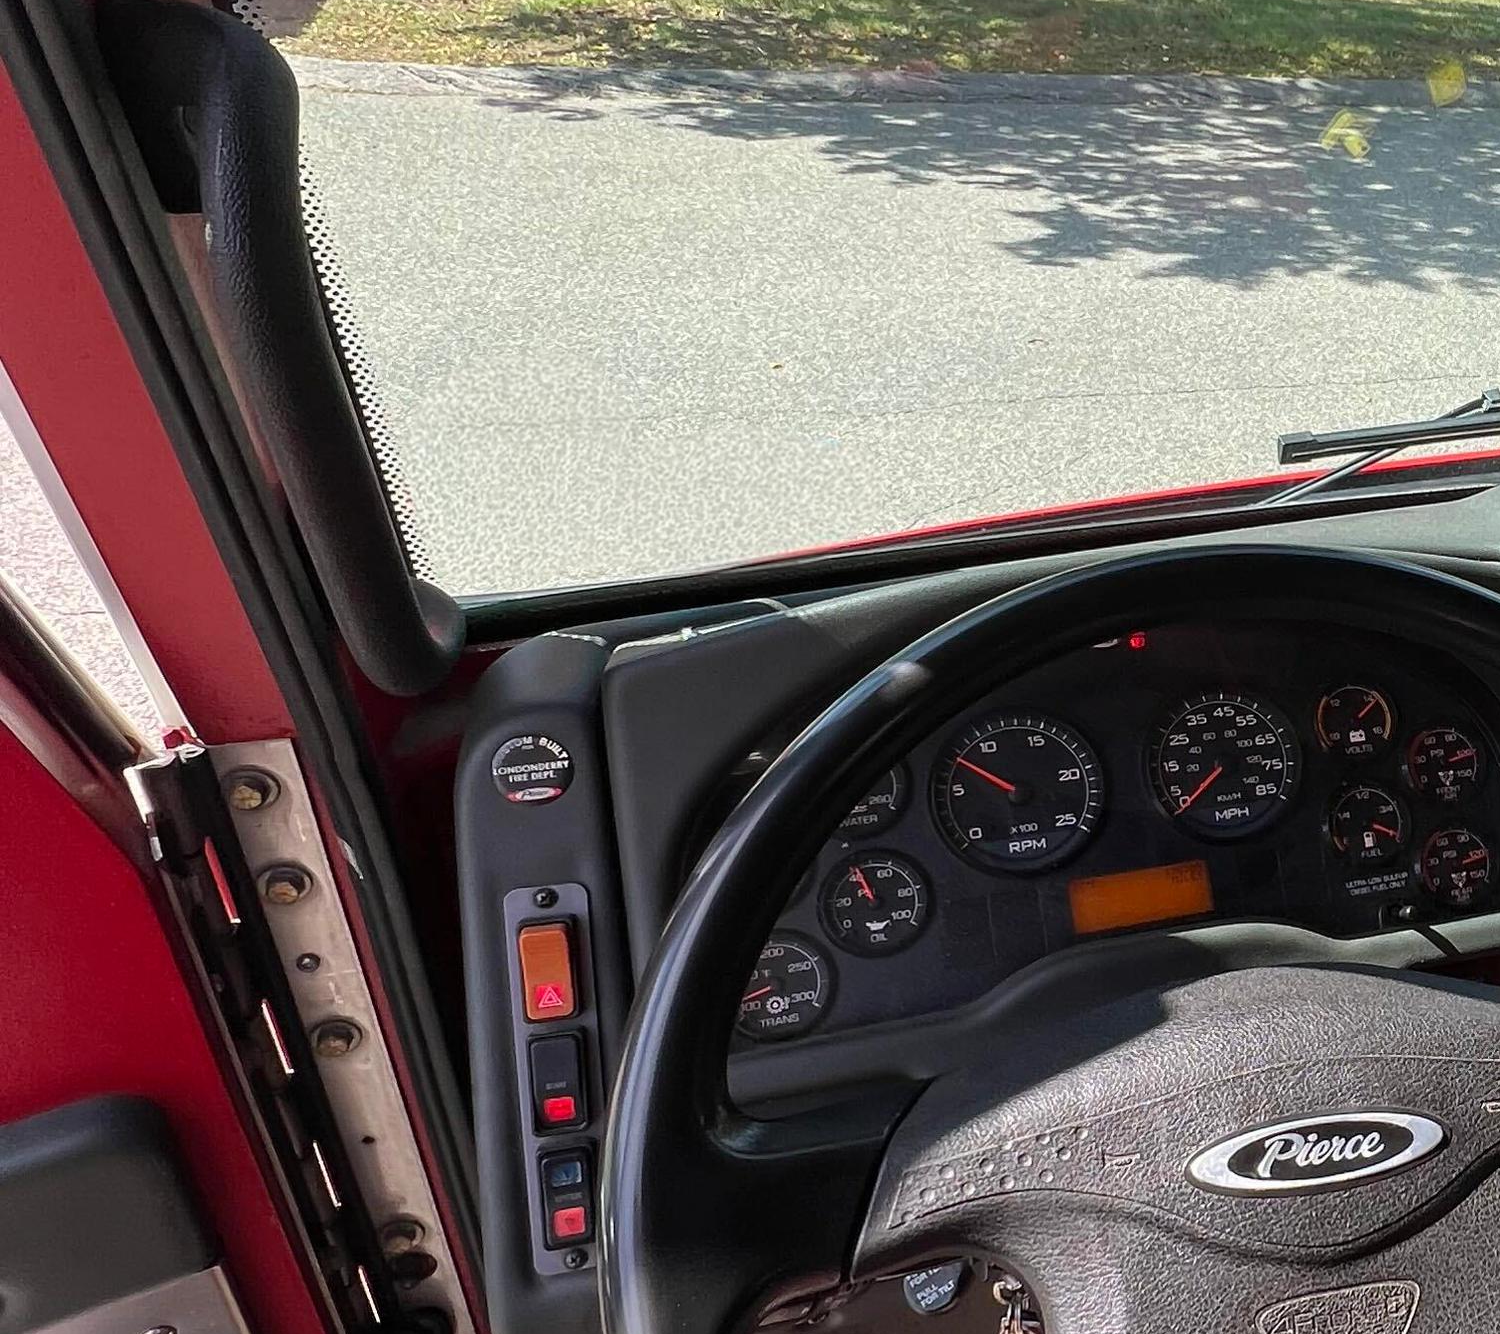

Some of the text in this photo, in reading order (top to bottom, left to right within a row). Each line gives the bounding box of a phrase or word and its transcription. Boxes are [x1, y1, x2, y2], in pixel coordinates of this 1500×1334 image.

[1213, 707, 1235, 718] 45
[1185, 713, 1207, 726] 35
[1235, 714, 1257, 727] 55
[1027, 735, 1045, 747] 15
[1169, 733, 1190, 746] 25
[1255, 733, 1276, 746] 65
[538, 736, 569, 760] BUILT
[980, 741, 997, 753] 10
[1188, 746, 1202, 754] 40
[493, 760, 569, 776] LONDONDERRY
[1163, 760, 1179, 772] 15
[1261, 758, 1283, 771] 75
[508, 773, 529, 783] FIRE
[1058, 768, 1080, 782] 20
[1420, 775, 1428, 783] 0
[1456, 769, 1472, 778] 150
[952, 784, 965, 796] 5
[1170, 785, 1181, 796] 5
[1255, 783, 1277, 796] 85
[1055, 813, 1077, 827] 25
[1214, 806, 1250, 822] MPH
[968, 827, 982, 840] 0
[1008, 837, 1047, 854] RPM
[1361, 847, 1384, 859] FUEL
[1372, 883, 1389, 892] FUEL
[1388, 879, 1406, 889] ONLY
[1433, 877, 1440, 886] 0
[836, 897, 852, 908] 20
[891, 909, 912, 921] 100
[842, 918, 852, 929] 0
[869, 932, 888, 944] OIL
[787, 961, 812, 973] 250
[760, 1012, 800, 1028] TRANS
[1257, 1131, 1385, 1178] Pierce
[916, 1283, 939, 1300] PULL
[920, 1279, 955, 1308] FOR TILT
